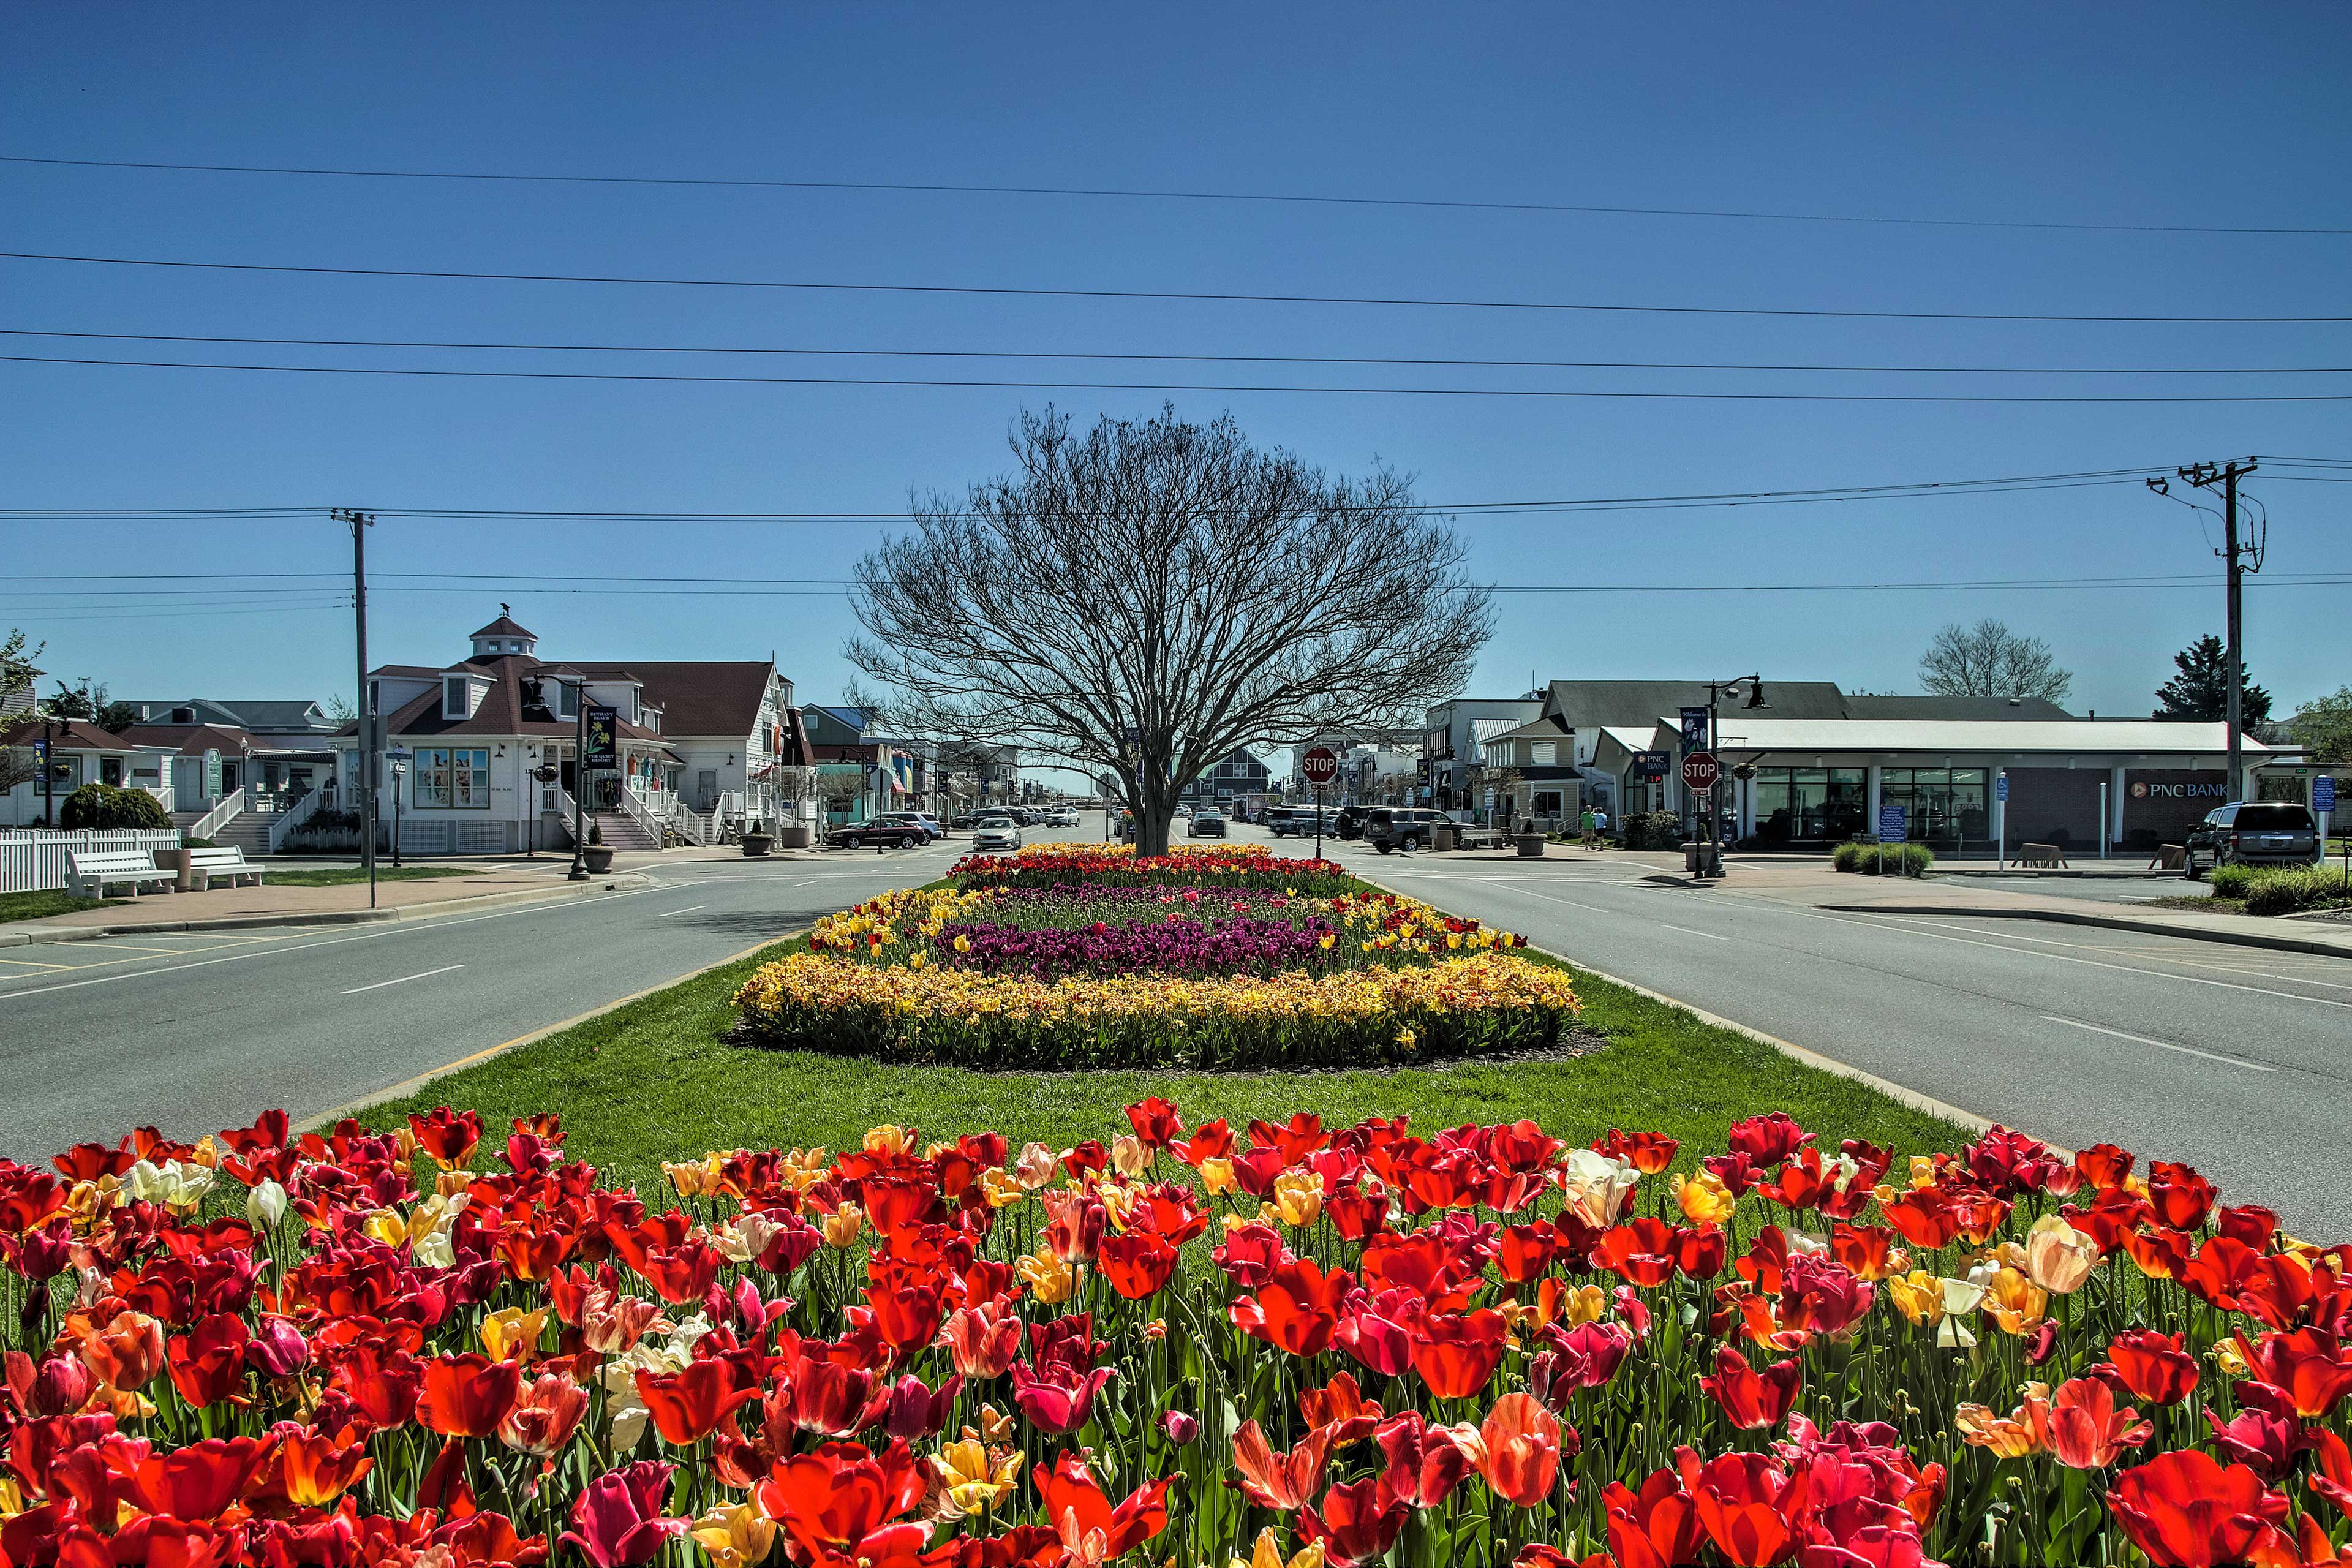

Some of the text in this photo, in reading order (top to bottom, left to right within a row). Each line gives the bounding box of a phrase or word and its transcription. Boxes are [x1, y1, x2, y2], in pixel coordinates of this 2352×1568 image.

[1304, 758, 1335, 771] STOP
[1684, 764, 1715, 777] STOP
[2149, 784, 2228, 797] PNC BANK
